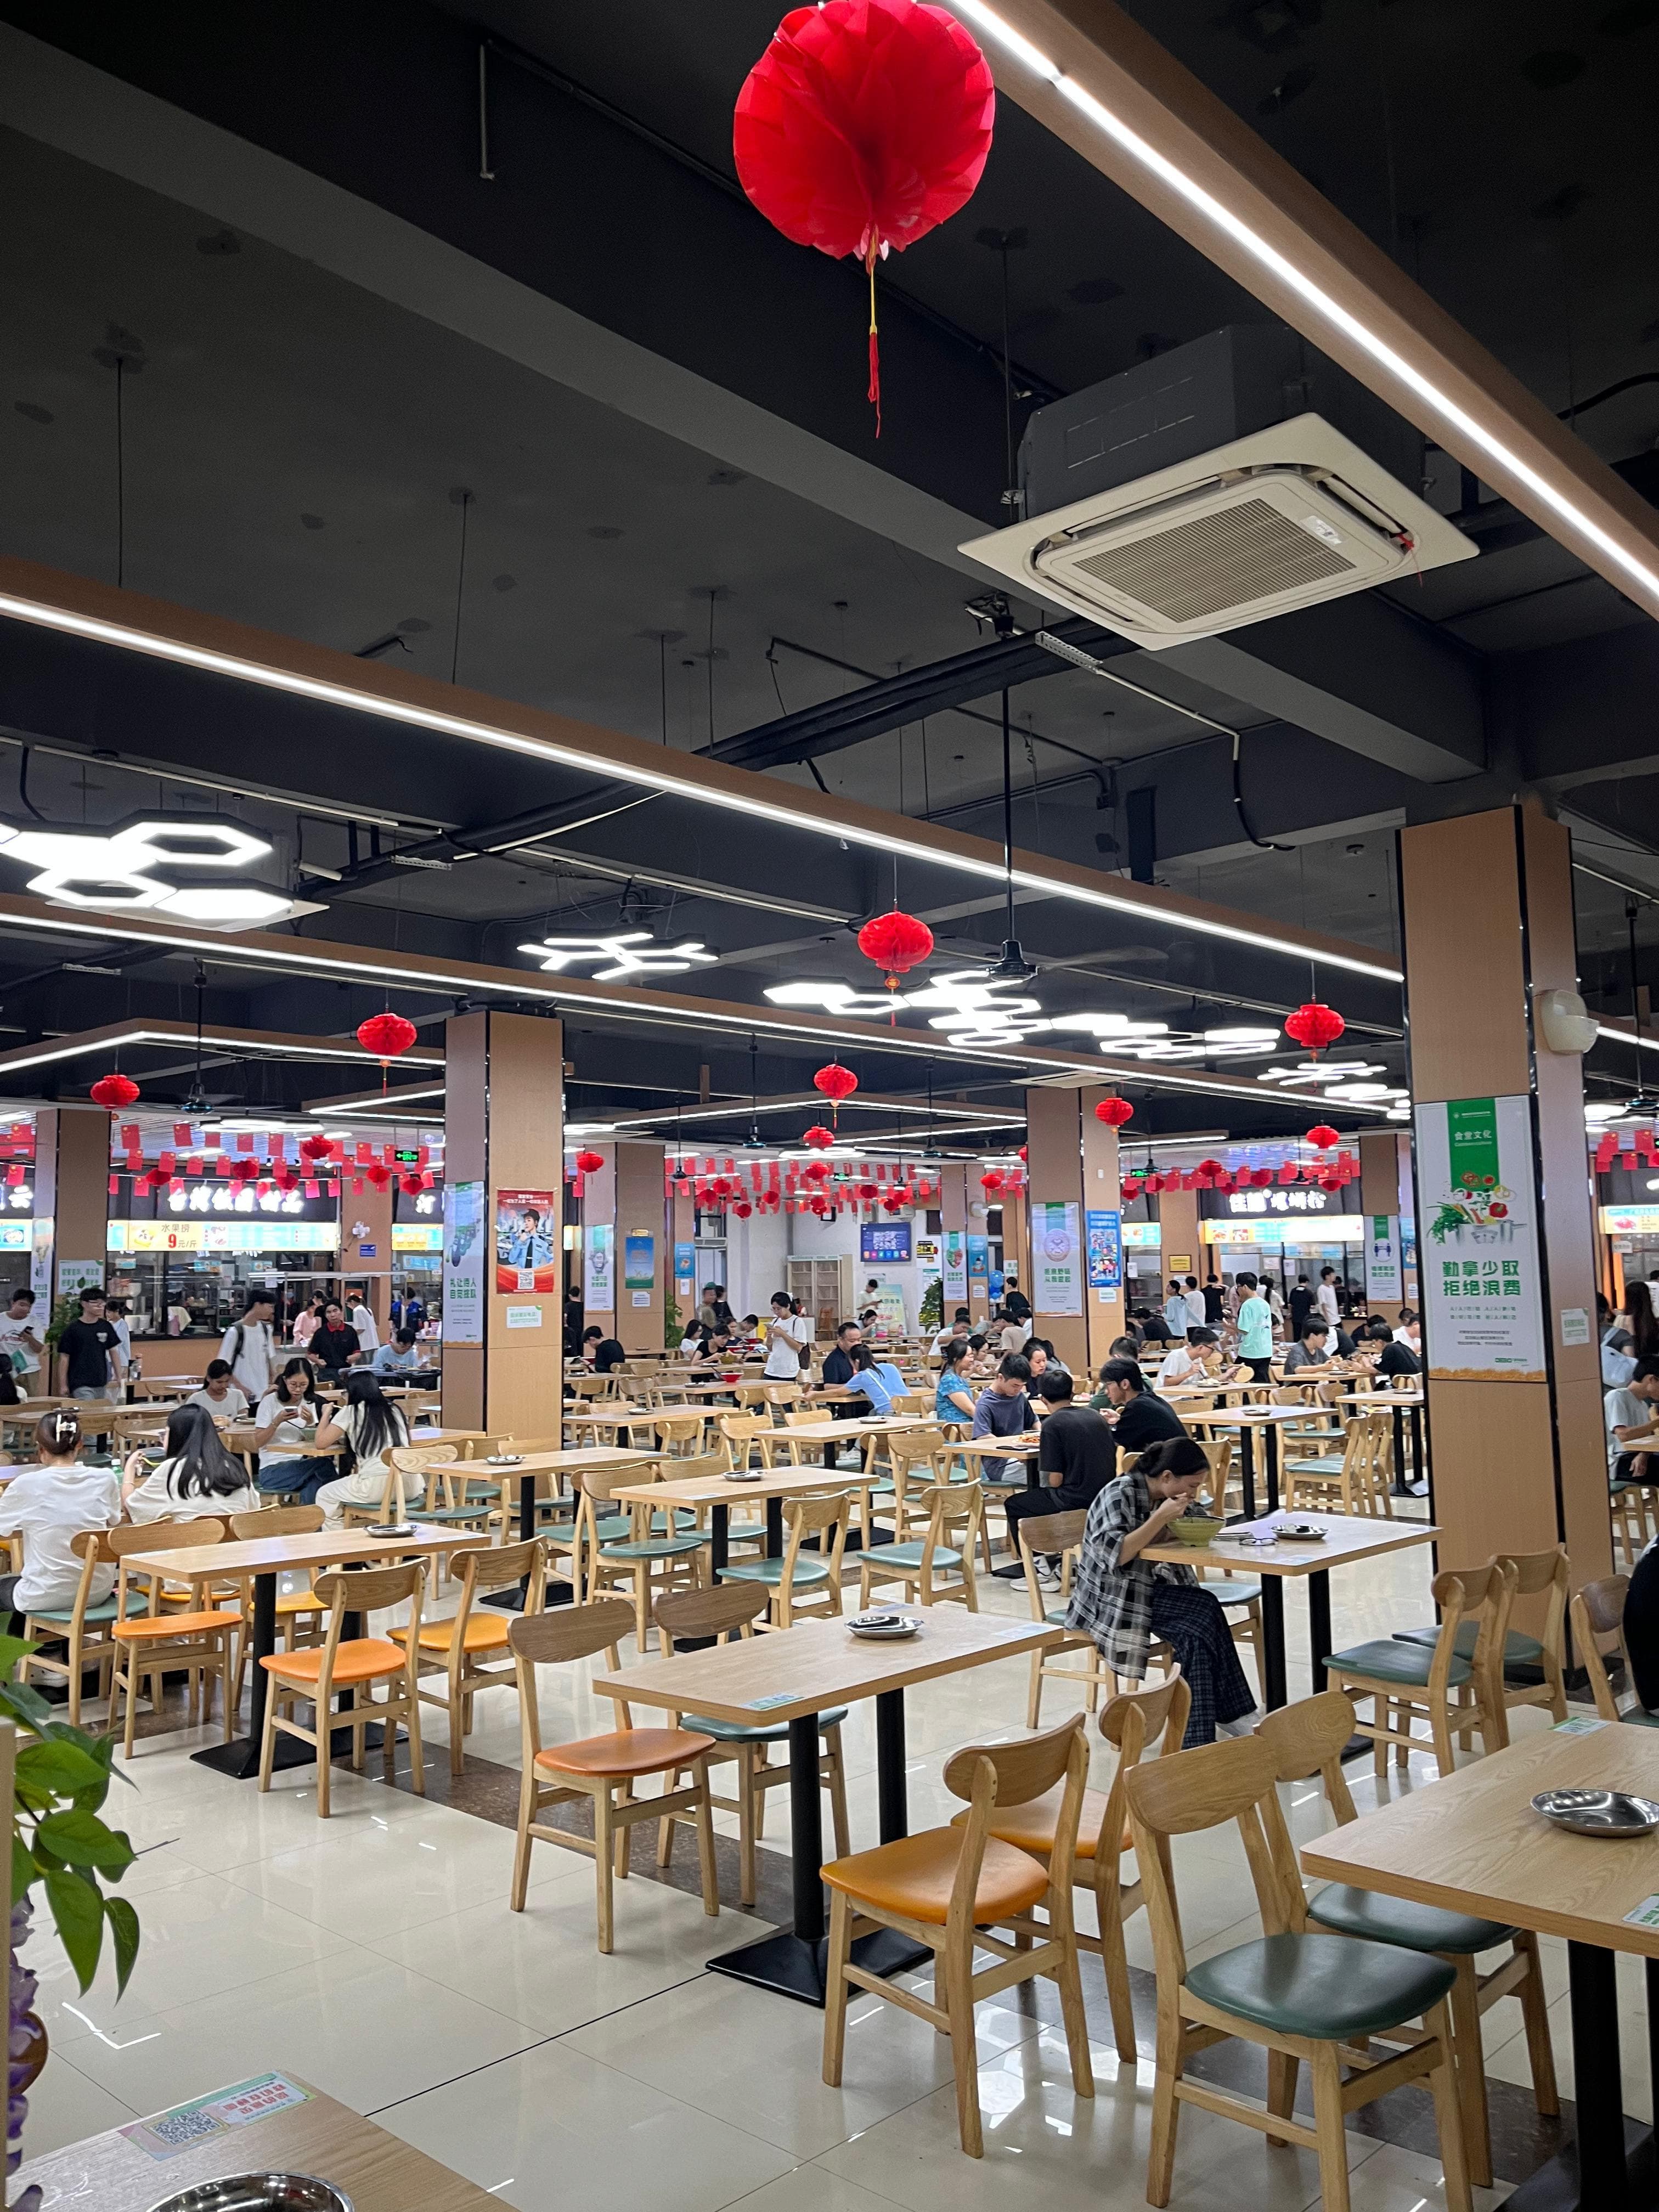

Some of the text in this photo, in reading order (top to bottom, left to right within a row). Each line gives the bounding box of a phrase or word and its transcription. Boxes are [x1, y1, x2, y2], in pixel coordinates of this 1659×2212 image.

[1442, 1260, 1520, 1277] 勤拿少取
[1443, 1280, 1521, 1296] 拒绝浪费
